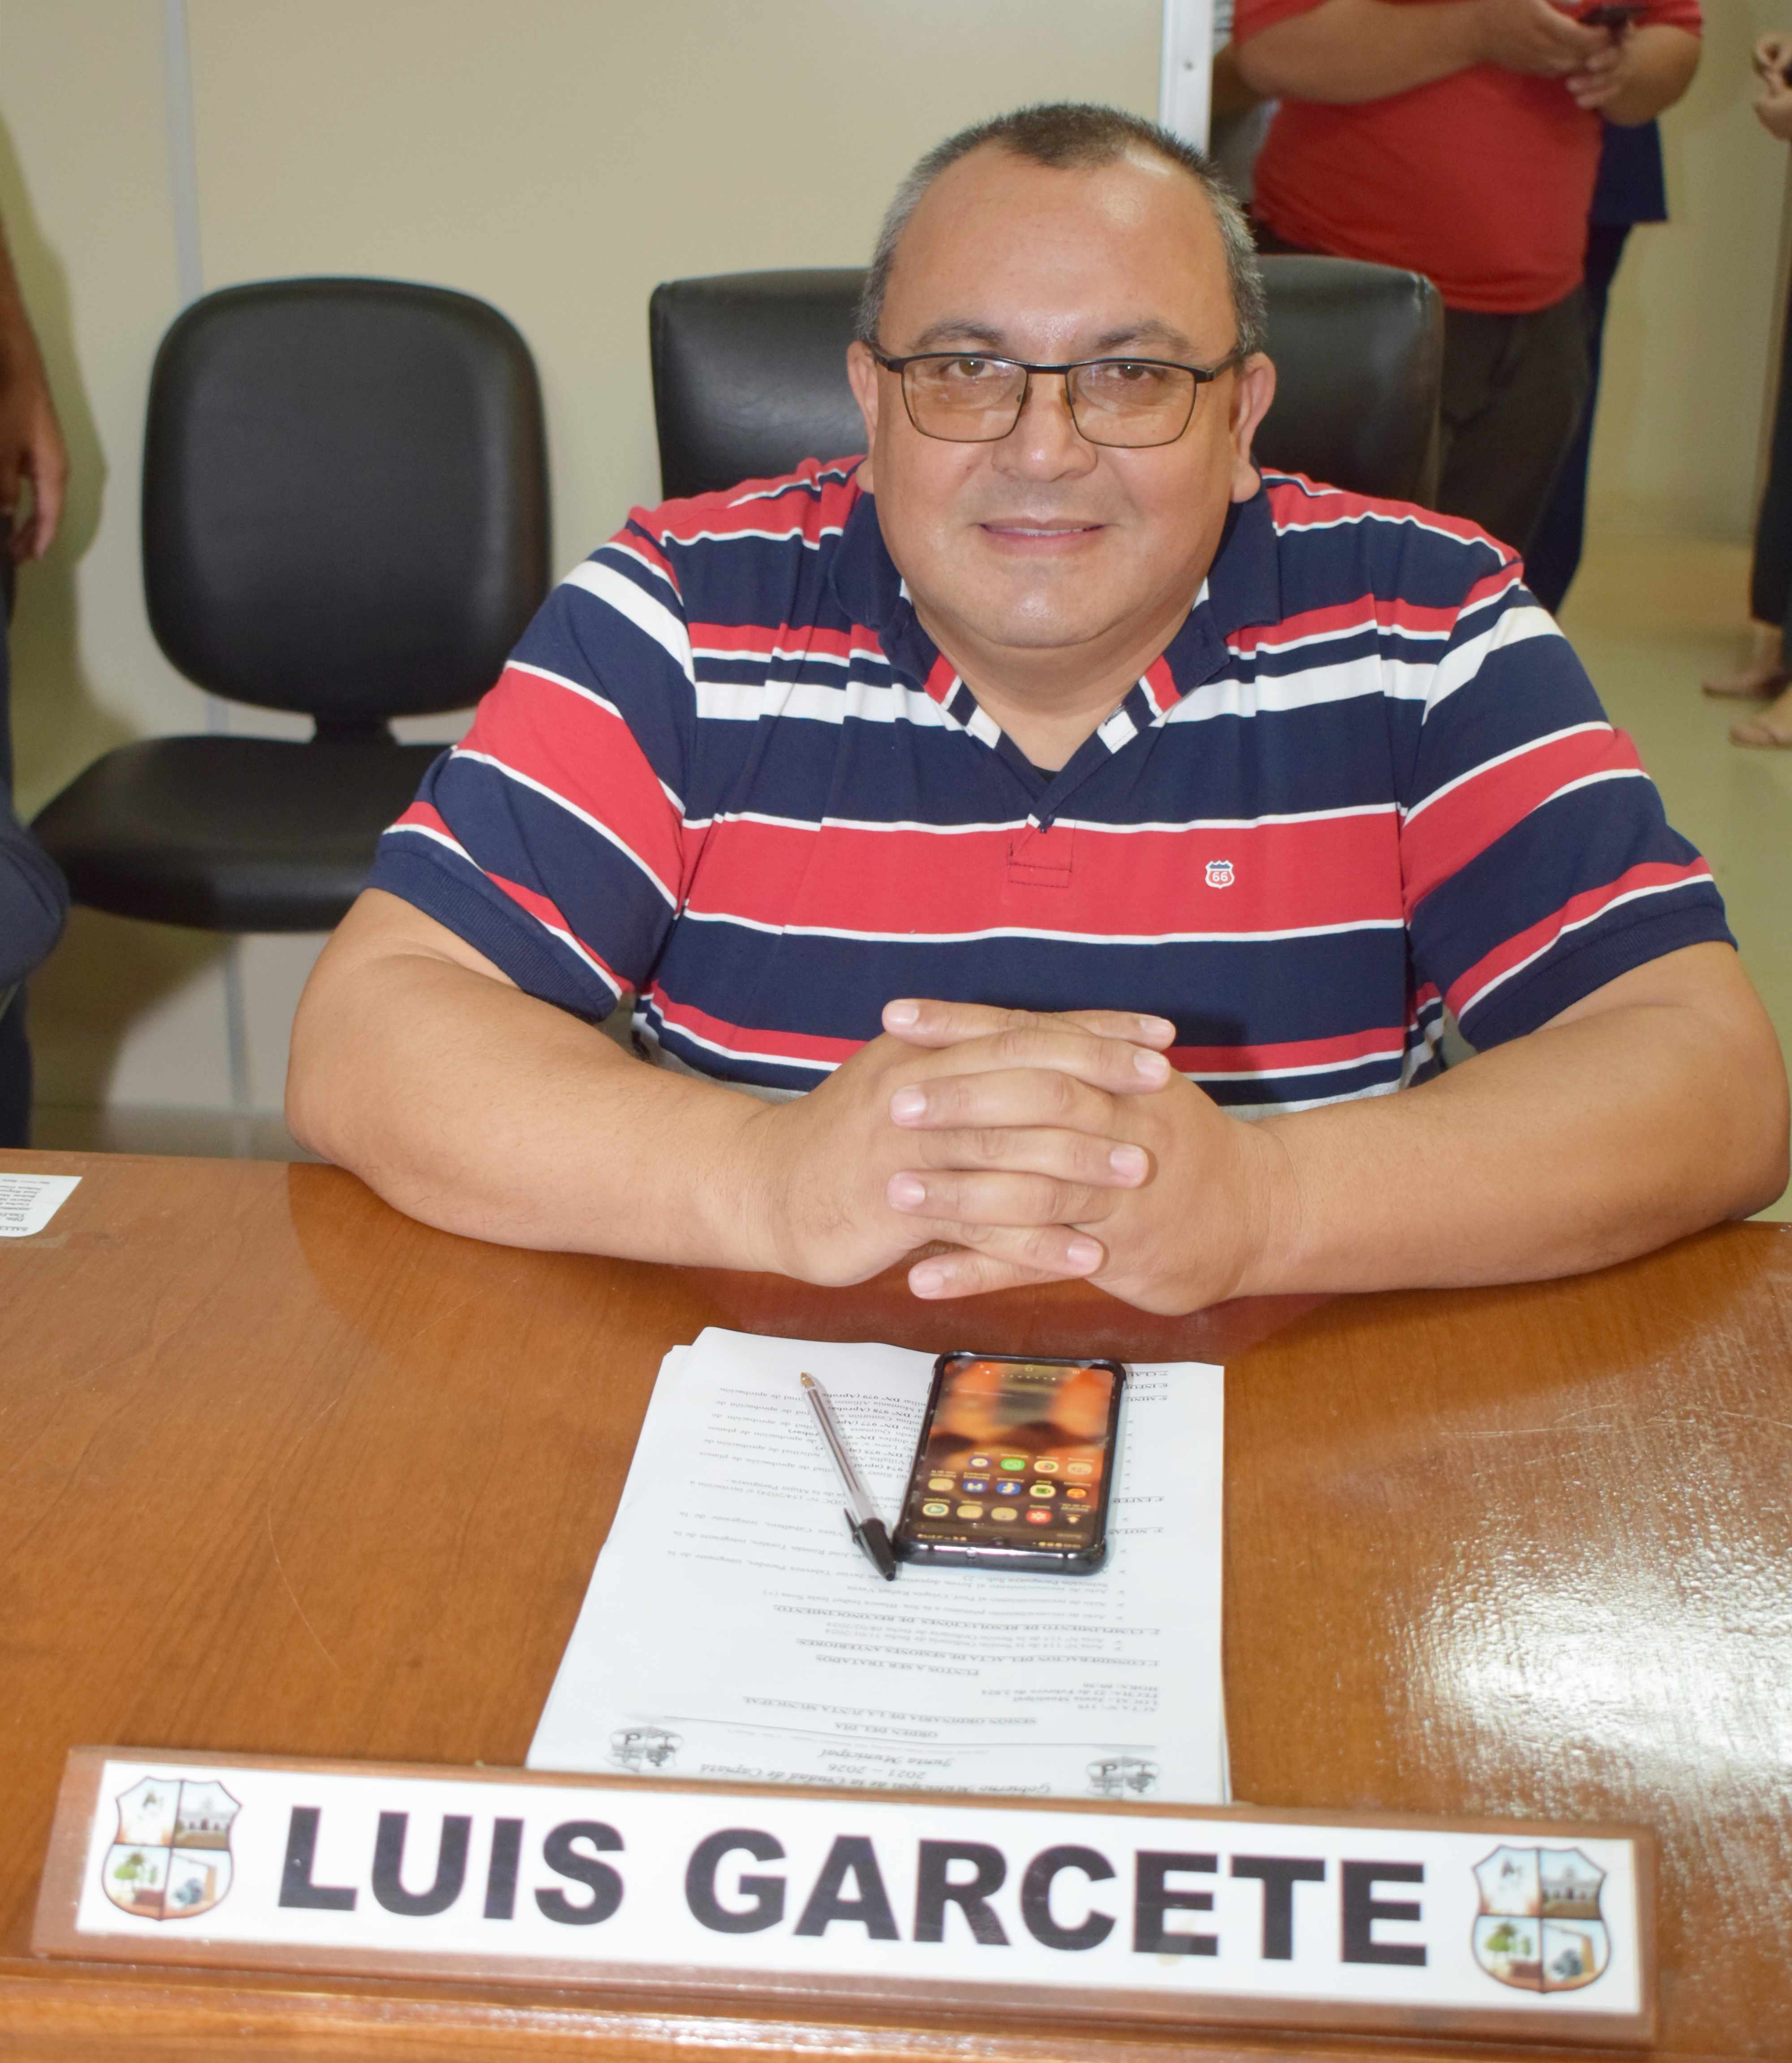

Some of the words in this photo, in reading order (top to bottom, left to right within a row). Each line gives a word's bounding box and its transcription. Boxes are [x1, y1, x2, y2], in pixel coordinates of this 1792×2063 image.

[1212, 871, 1228, 882] 66
[720, 1387, 767, 1398] aprobación
[730, 1402, 778, 1413] aprobación
[727, 1415, 775, 1426] aprobación
[849, 1413, 892, 1422] Centurión
[707, 1426, 737, 1434] planos
[851, 1427, 890, 1435] Quintana
[754, 1431, 802, 1442] aprobación
[879, 1436, 908, 1445] dúplex
[717, 1440, 766, 1451] aprobación
[699, 1451, 728, 1460] planos
[782, 1449, 820, 1458] solicitud
[745, 1458, 795, 1469] aprobación
[870, 1456, 905, 1465] Villalba
[698, 1482, 743, 1493] invitación
[781, 1485, 809, 1494] Mujer
[712, 1515, 758, 1526] integrante
[818, 1529, 843, 1537] Viera
[700, 1533, 746, 1545] integrante
[791, 1546, 825, 1555] Román
[829, 1550, 850, 1558] José
[695, 1553, 742, 1565] integrante
[1008, 1577, 1058, 1585] Paraguaya
[774, 1604, 894, 1621] RECONOCIMIENTO:
[1042, 1625, 1143, 1634] CUMPLIMIENTO
[796, 1638, 881, 1652] ANTERIORES:
[885, 1647, 945, 1658] SESIONES
[816, 1654, 884, 1667] TRATADOS
[887, 1661, 913, 1670] SER
[928, 1666, 979, 1676] PUNTOS
[742, 1697, 818, 1711] MUNICIPAL
[822, 1705, 864, 1716] JUNTA
[889, 1712, 905, 1720] DE
[909, 1714, 985, 1724] ORDINARIA
[861, 1725, 887, 1734] DEL
[891, 1727, 939, 1738] ORDEN
[818, 1748, 903, 1763] Municipal
[907, 1757, 954, 1767] Junta
[828, 1763, 867, 1774] 2026
[888, 1769, 926, 1779] 2021
[278, 1806, 626, 1925] LUIS
[684, 1827, 1427, 1967] GARCETE
